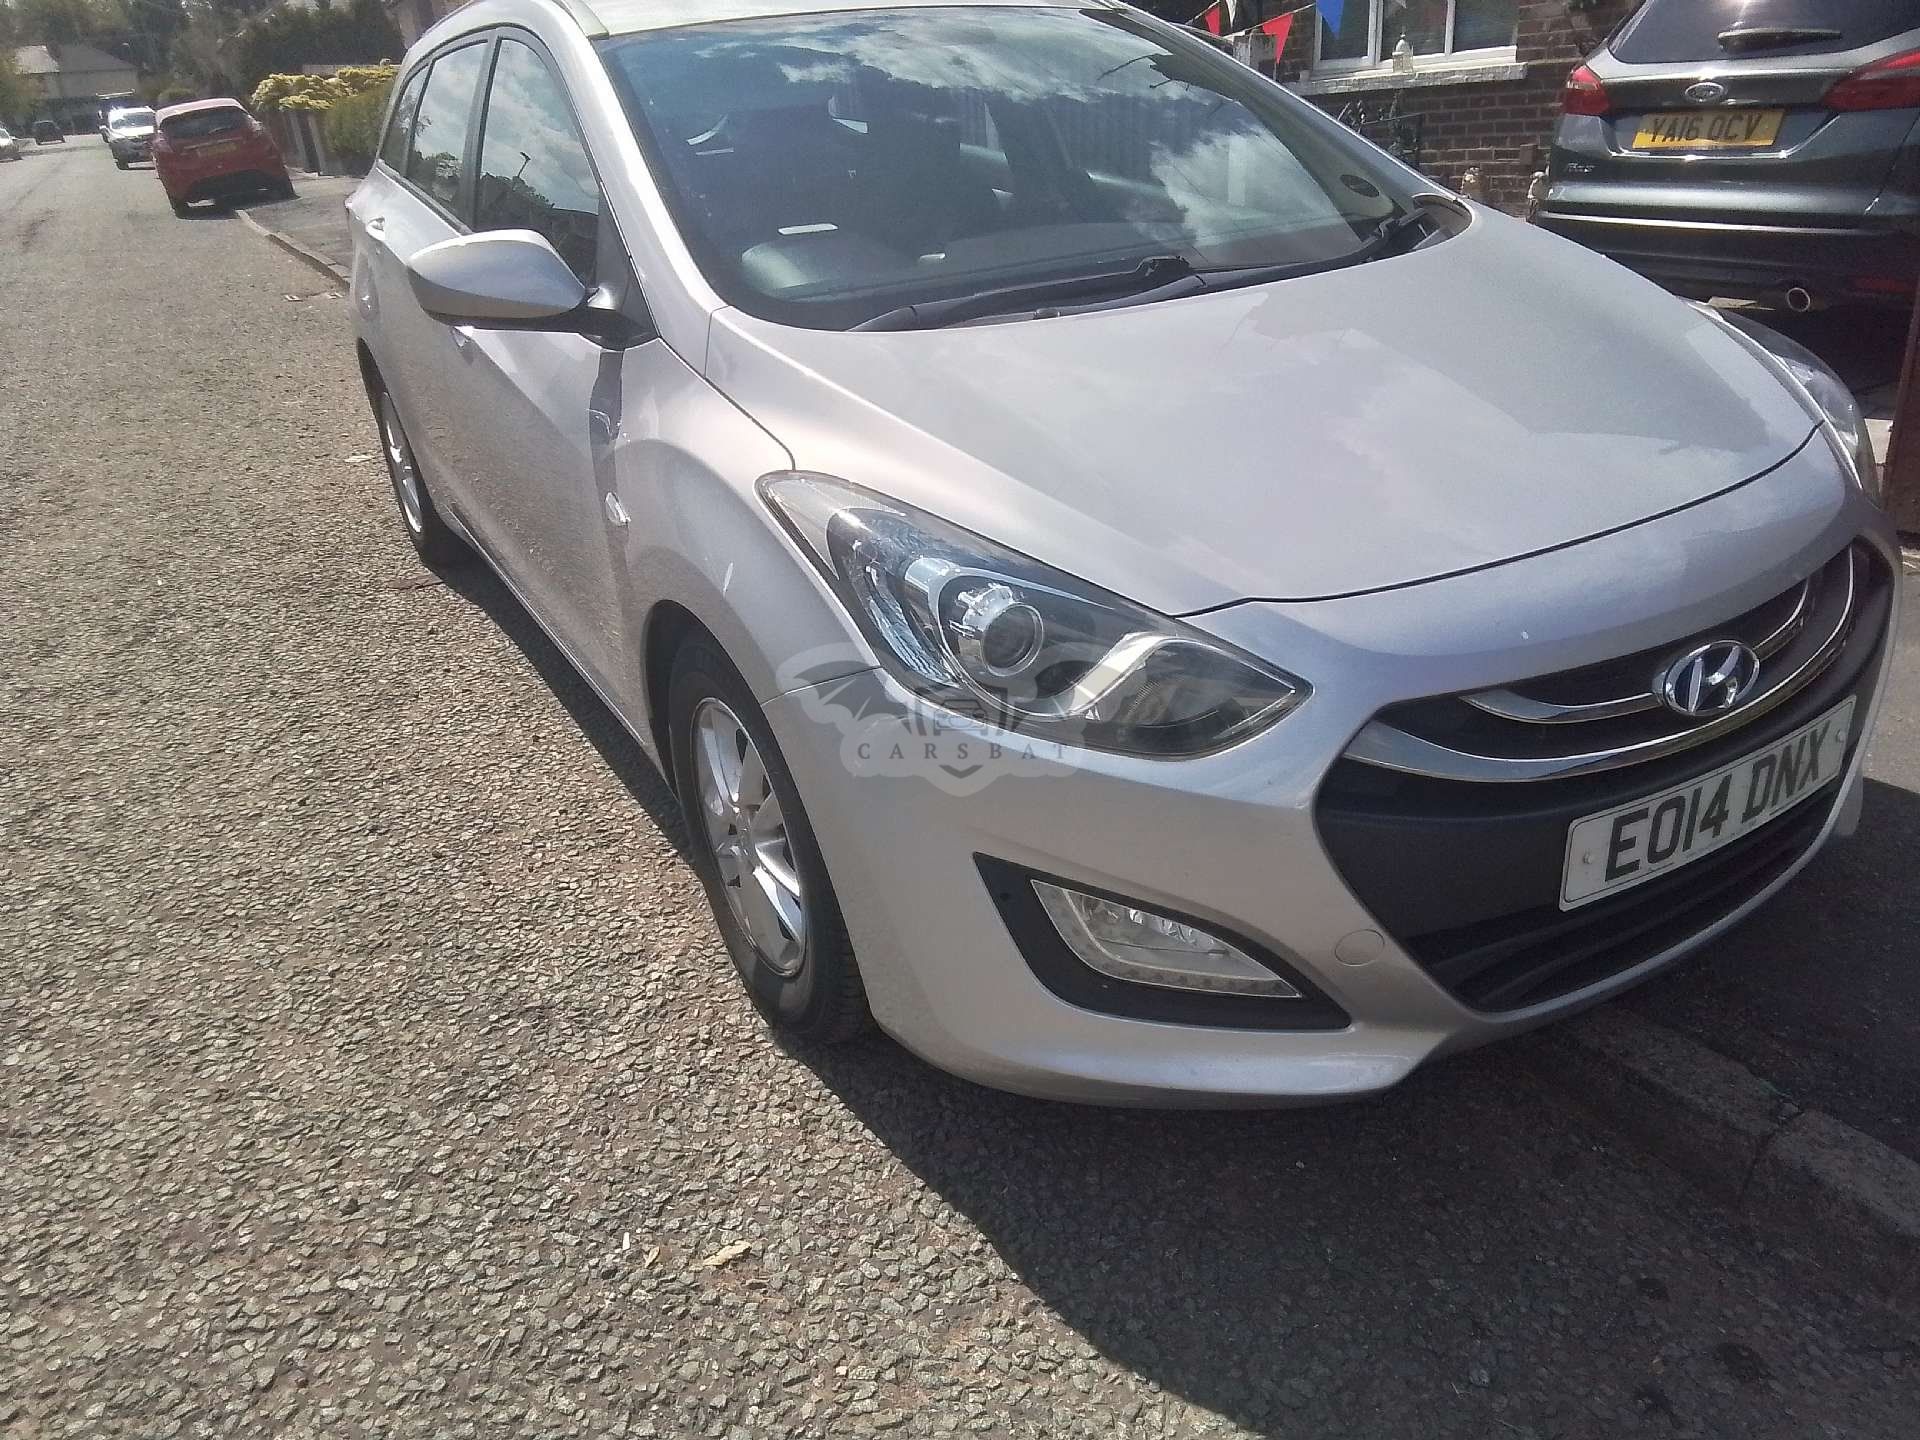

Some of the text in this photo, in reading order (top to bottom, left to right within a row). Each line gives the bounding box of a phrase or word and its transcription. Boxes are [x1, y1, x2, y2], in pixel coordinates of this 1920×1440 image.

[1650, 115, 1703, 143] YA16
[1604, 720, 1831, 882] EO14 DNX
